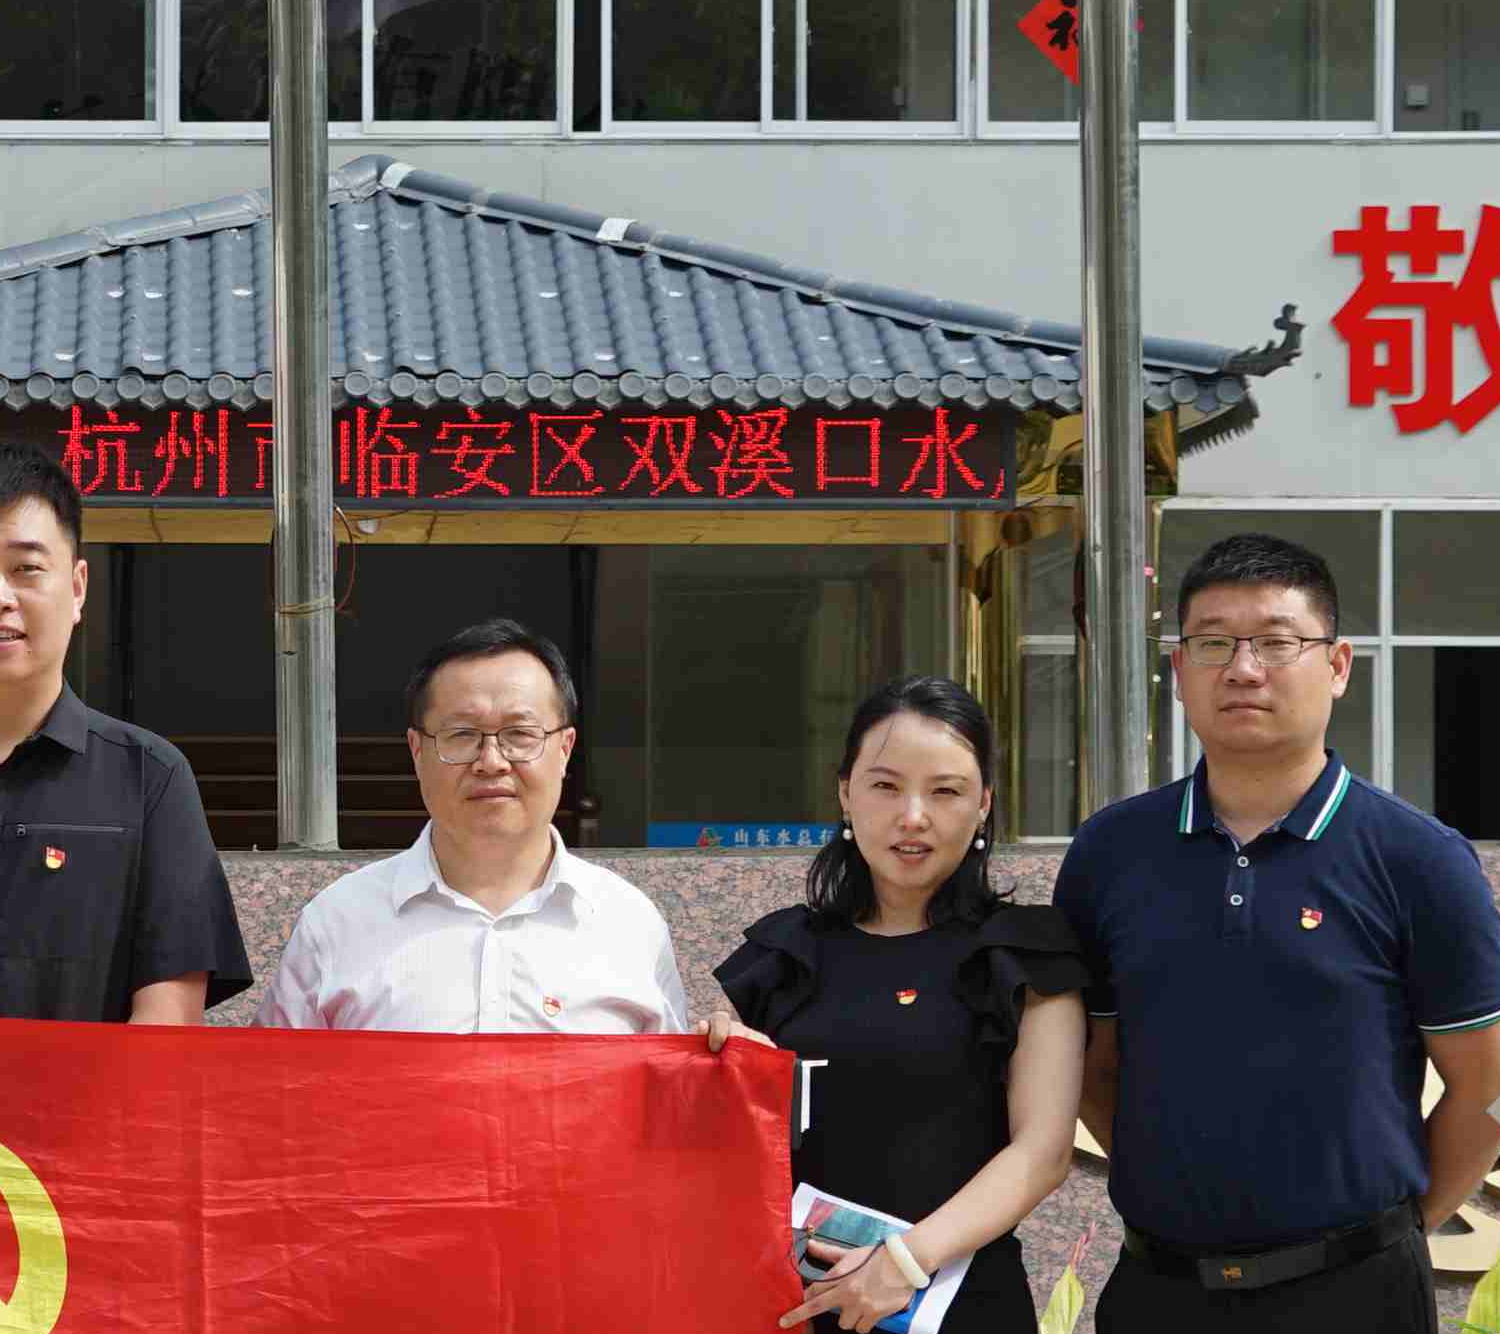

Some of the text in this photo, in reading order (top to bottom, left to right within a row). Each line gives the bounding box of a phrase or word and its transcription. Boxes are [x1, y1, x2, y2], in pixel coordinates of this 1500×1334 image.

[62, 406, 1003, 499] 杭州临安区双溪口水
